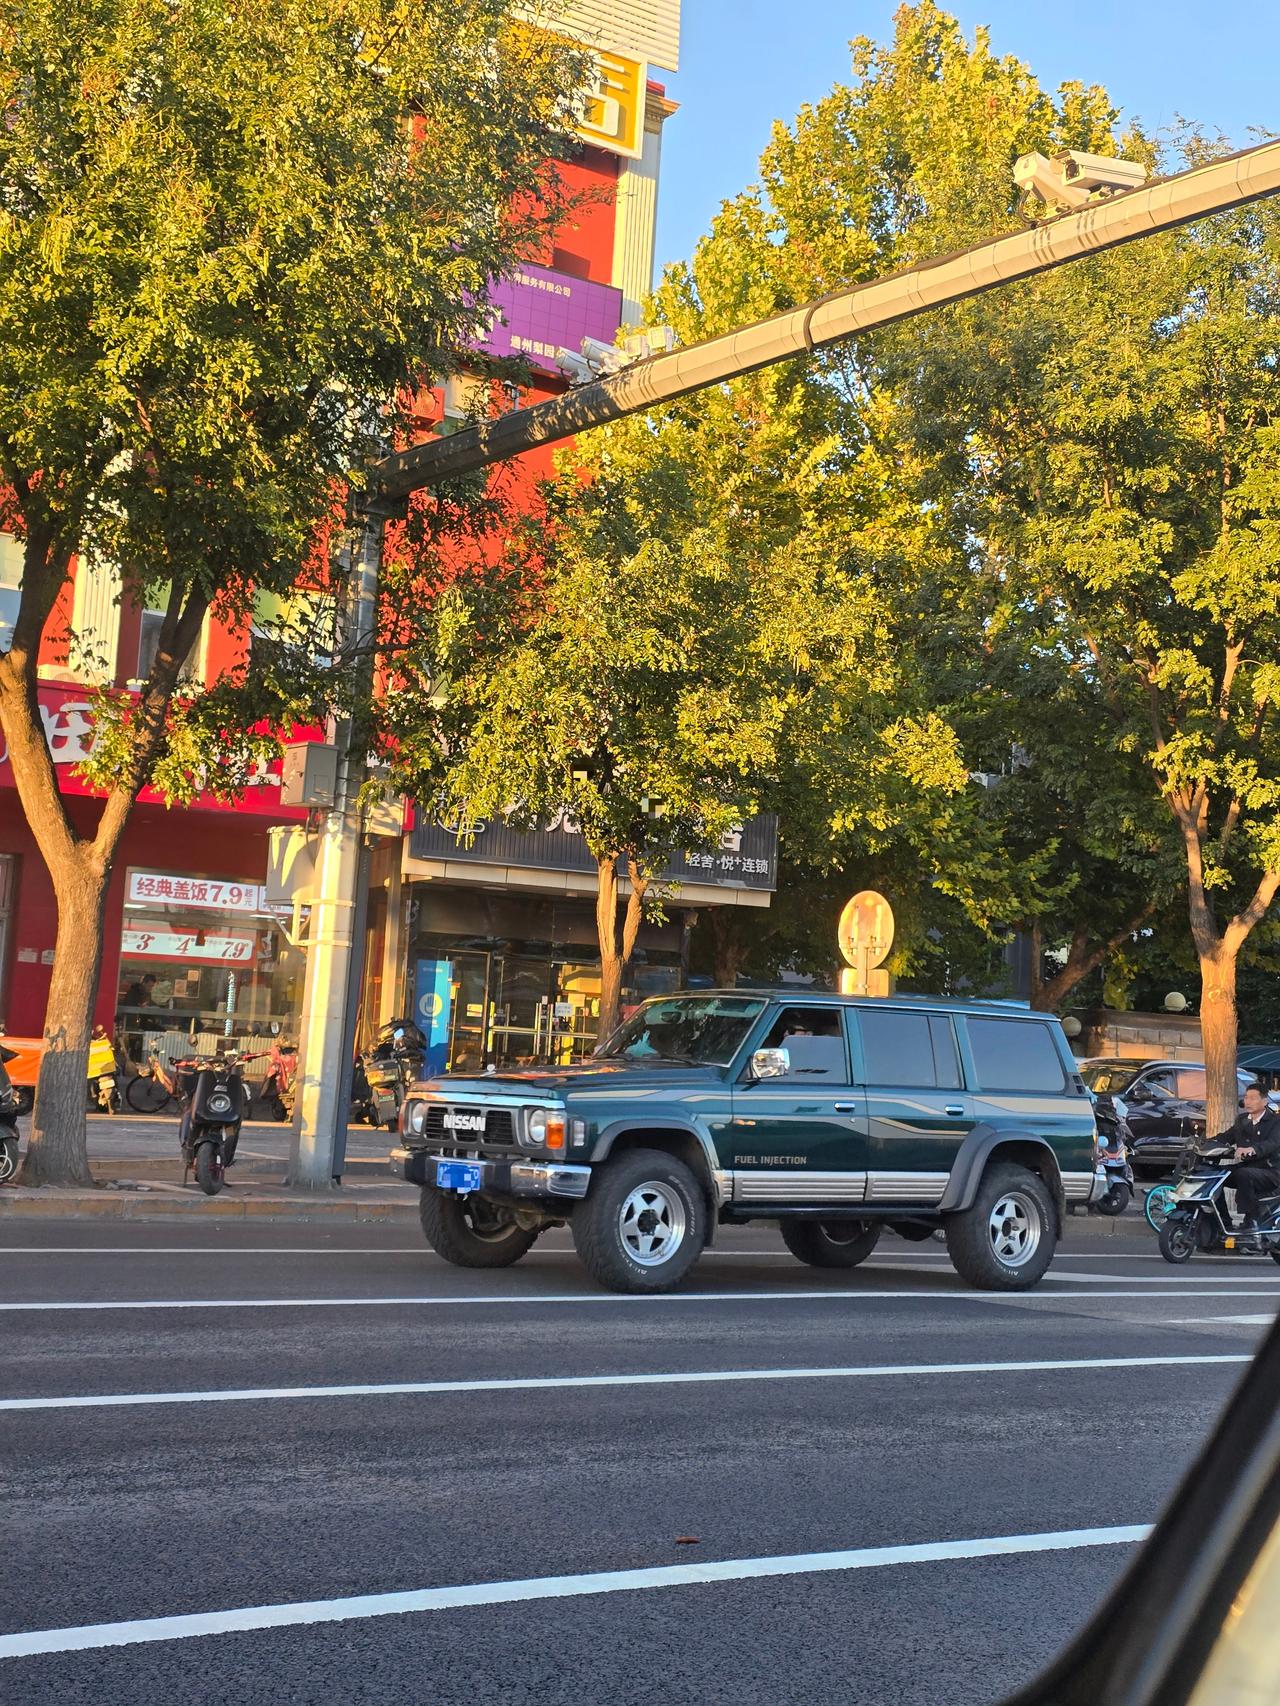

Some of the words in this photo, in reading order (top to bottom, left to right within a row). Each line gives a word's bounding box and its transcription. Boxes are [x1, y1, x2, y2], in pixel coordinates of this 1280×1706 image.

[443, 1114, 486, 1131] NISSAN
[734, 1155, 758, 1164] FUEL
[760, 1155, 807, 1166] INJECTION
